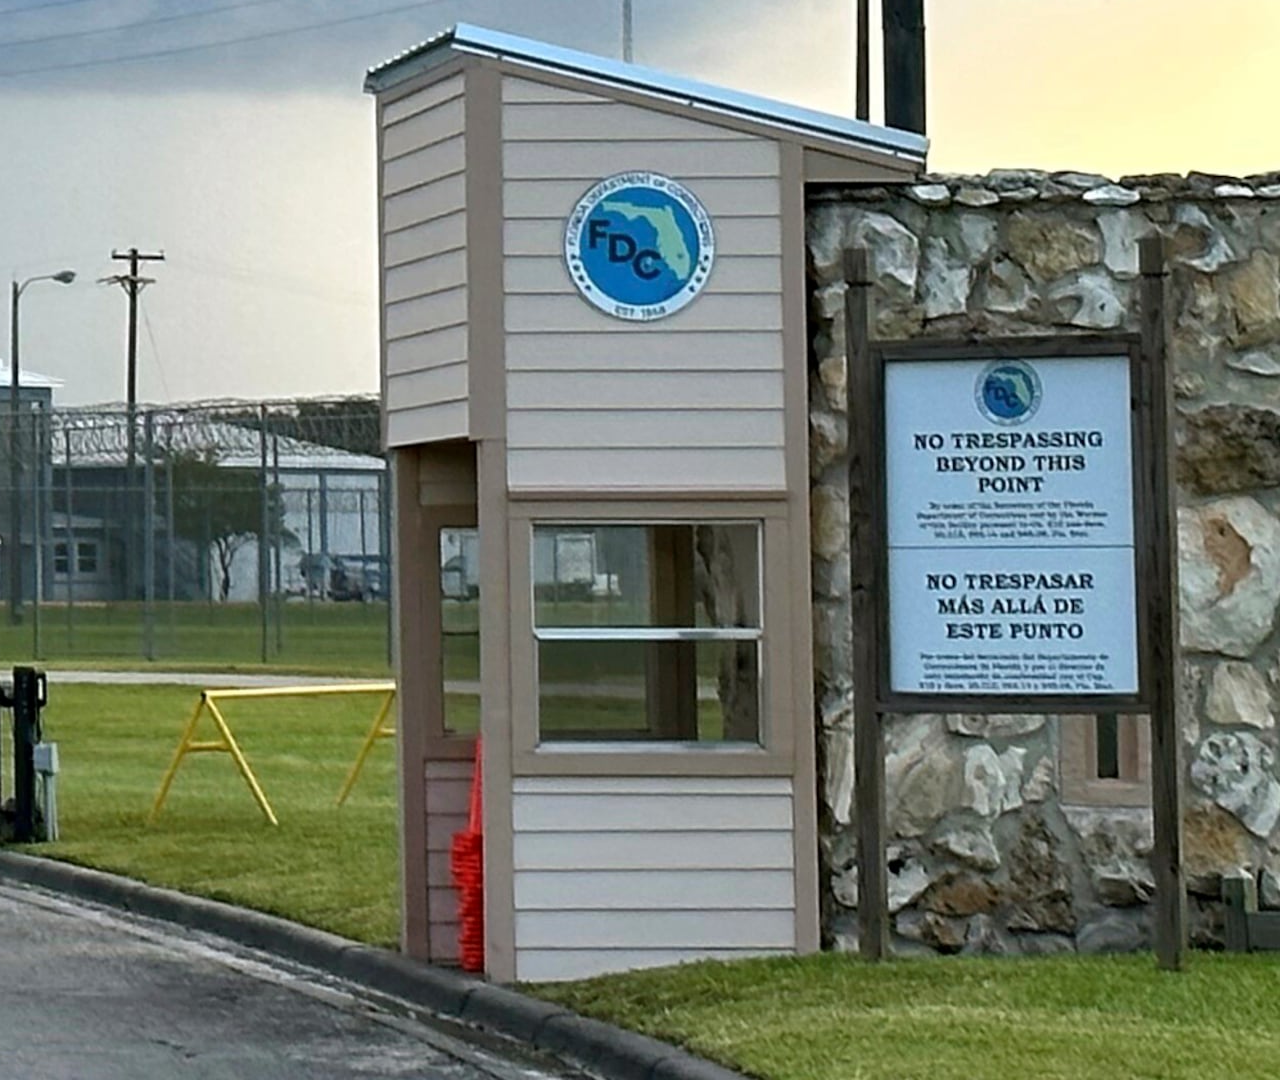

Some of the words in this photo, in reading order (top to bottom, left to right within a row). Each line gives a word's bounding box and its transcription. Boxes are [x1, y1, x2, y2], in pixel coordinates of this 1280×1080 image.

[589, 220, 662, 280] FDC
[986, 380, 1019, 408] FDC
[914, 434, 944, 450] NO
[951, 432, 1102, 449] TRESPASSING
[937, 456, 1026, 472] BEYOND
[1033, 455, 1085, 471] THIS
[979, 477, 1044, 493] POINT
[926, 574, 957, 590] NO
[964, 574, 1093, 590] TRESPASAR
[937, 595, 984, 614] MÁS
[991, 595, 1047, 614] ALLÁ
[1054, 599, 1084, 614] DE
[946, 623, 1002, 639] ESTE
[1010, 623, 1083, 639] PUNTO
